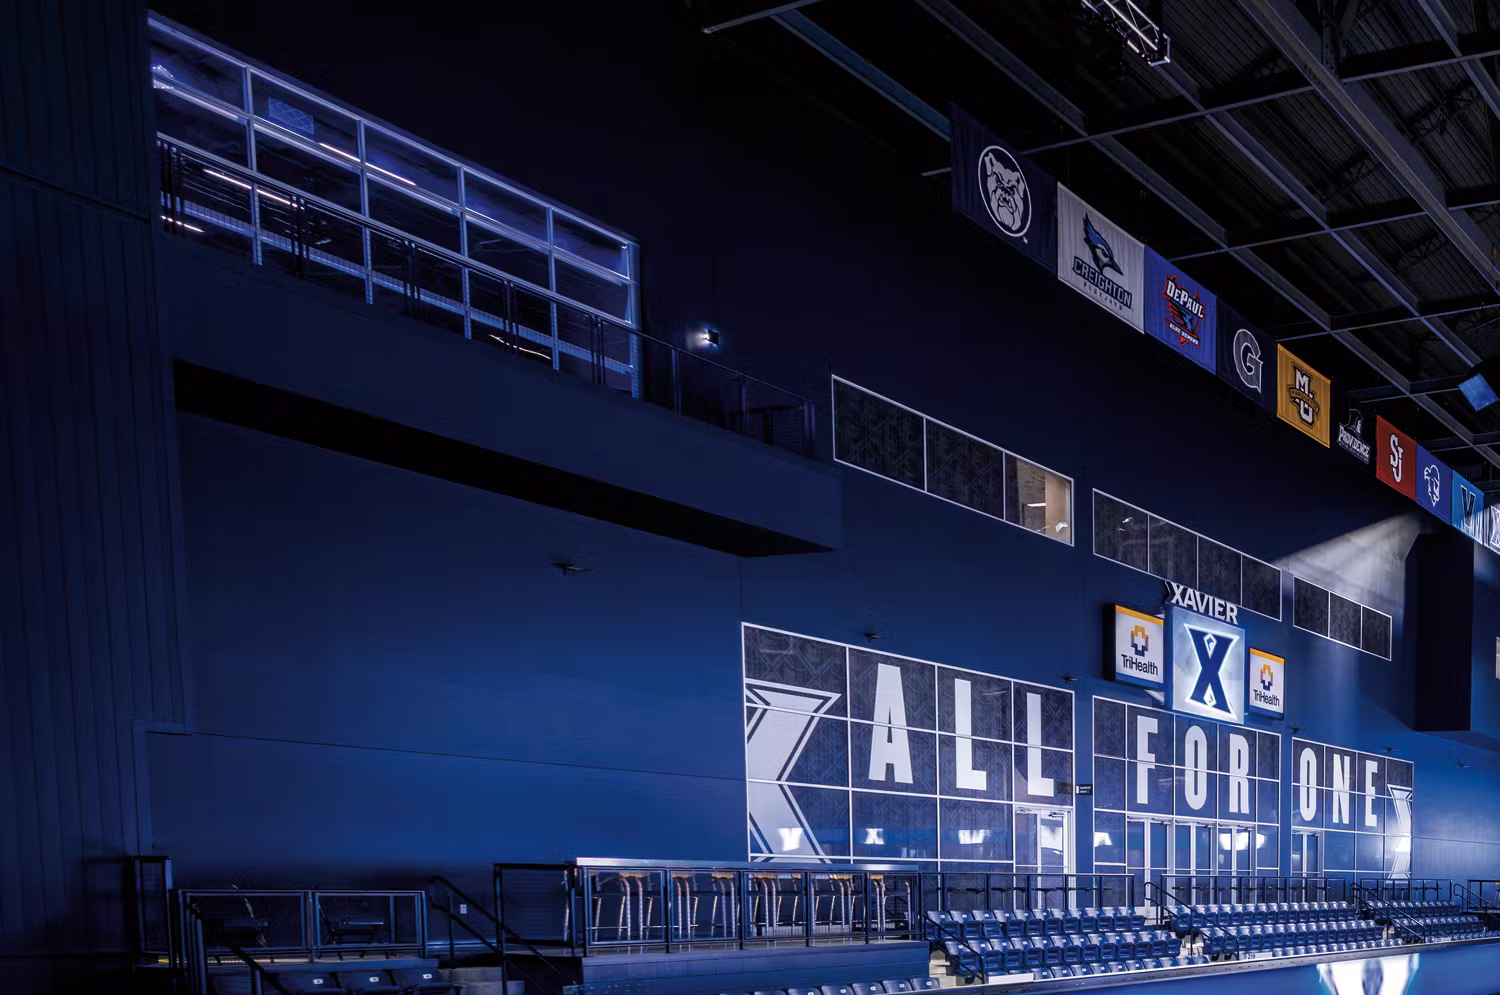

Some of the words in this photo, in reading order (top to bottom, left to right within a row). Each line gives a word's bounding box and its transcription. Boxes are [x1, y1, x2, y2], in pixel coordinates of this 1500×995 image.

[1072, 257, 1132, 310] CREIGHTON
[1338, 425, 1370, 458] PROVIDENCE
[1170, 581, 1239, 625] XAVIER
[1121, 653, 1159, 676] TriHealth
[1253, 689, 1280, 707] TriHealth
[868, 663, 1055, 797] ALL
[1136, 715, 1249, 815] FOR
[1300, 747, 1379, 828] ONE
